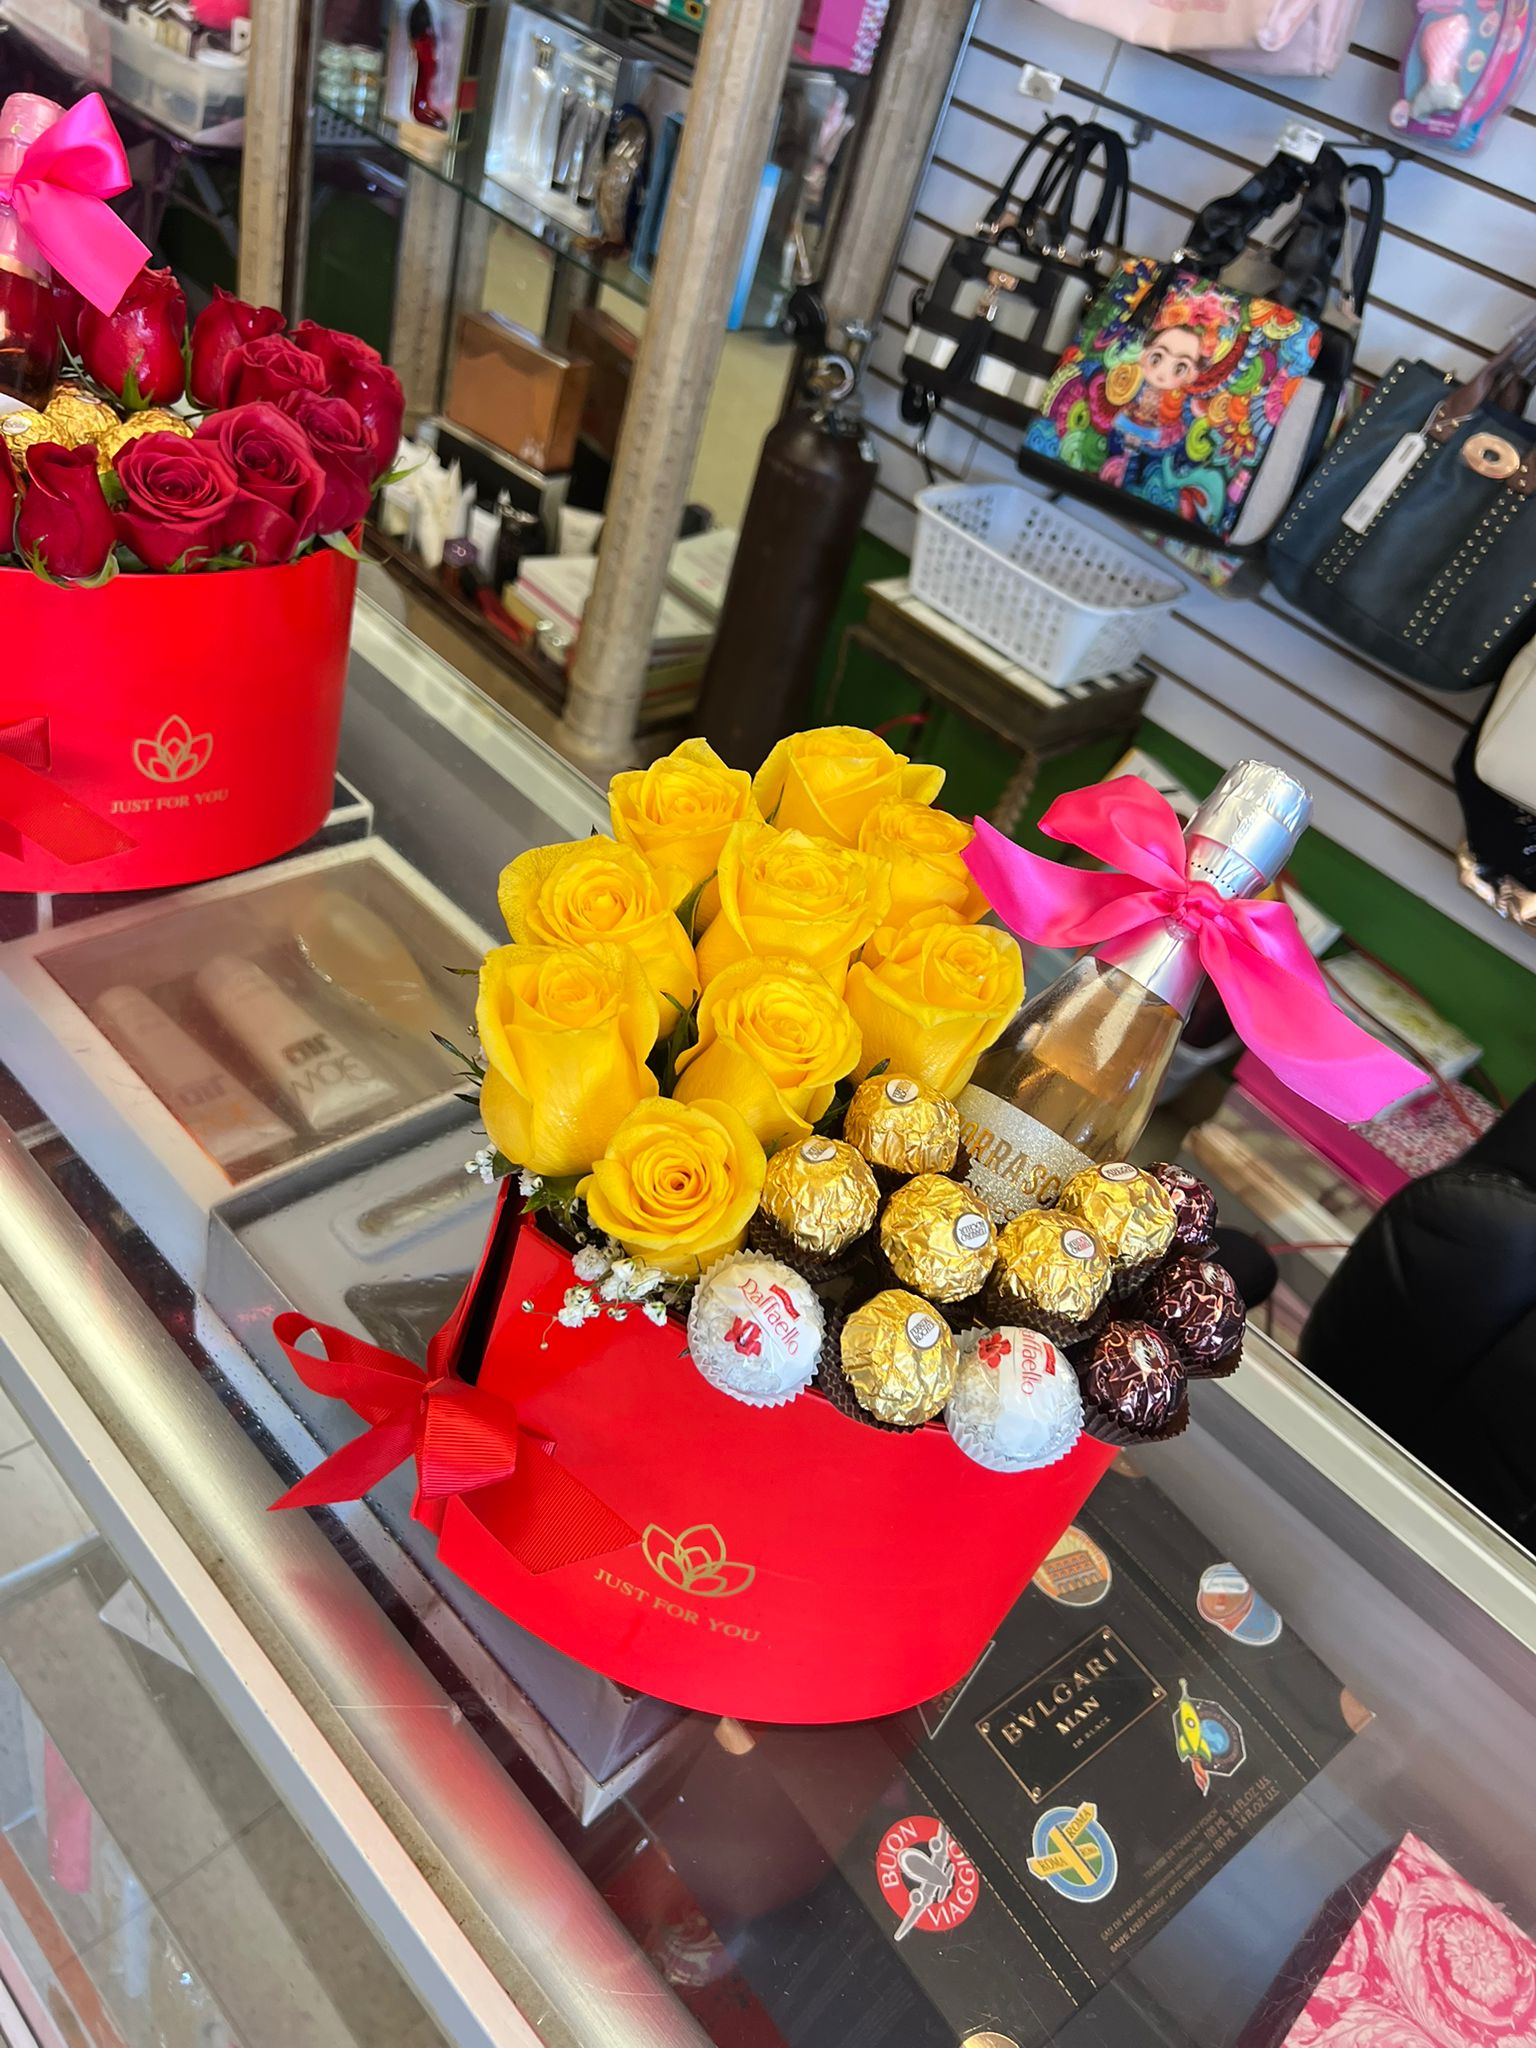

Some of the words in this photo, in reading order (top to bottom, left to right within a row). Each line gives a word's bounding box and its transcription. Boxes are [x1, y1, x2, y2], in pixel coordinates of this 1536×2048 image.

[111, 799, 153, 814] JUST
[157, 795, 190, 811] FOR
[194, 788, 229, 805] YOU
[959, 1117, 1061, 1206] ORRASC
[738, 1278, 799, 1356] Raffaello
[1021, 1328, 1043, 1396] affaello
[594, 1568, 649, 1602] JUST
[652, 1596, 700, 1625] FOR
[707, 1617, 761, 1642] YOU
[1001, 1648, 1119, 1745] BVLGARI
[1056, 1695, 1100, 1736] MAN
[880, 1821, 918, 1888] BUON
[1065, 1808, 1092, 1840] ROMA
[927, 1840, 977, 1927] VIAGGIO
